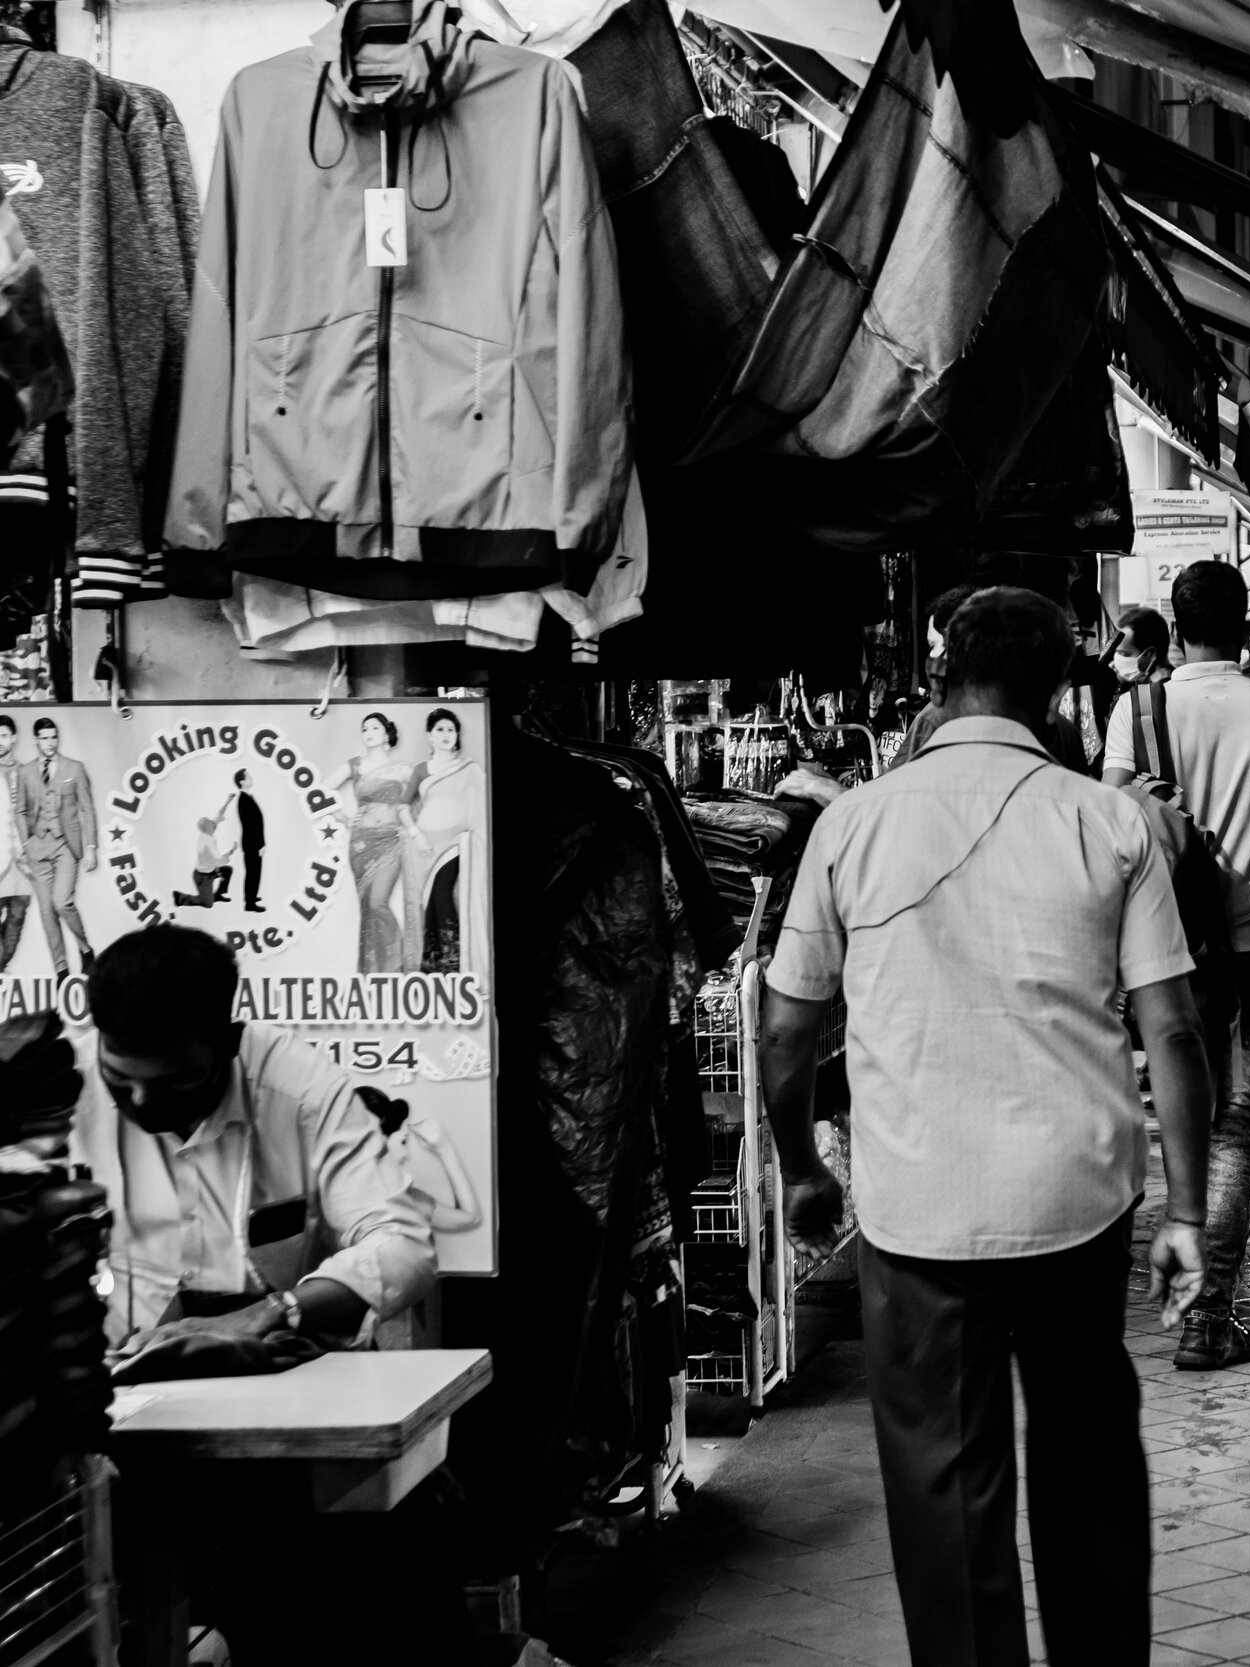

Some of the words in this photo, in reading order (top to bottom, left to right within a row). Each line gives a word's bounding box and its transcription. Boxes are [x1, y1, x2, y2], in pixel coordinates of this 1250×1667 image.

[112, 723, 240, 814] Looking
[253, 729, 337, 814] Good
[289, 855, 341, 923] Ltd.
[236, 976, 479, 1021] ALTERATIONS
